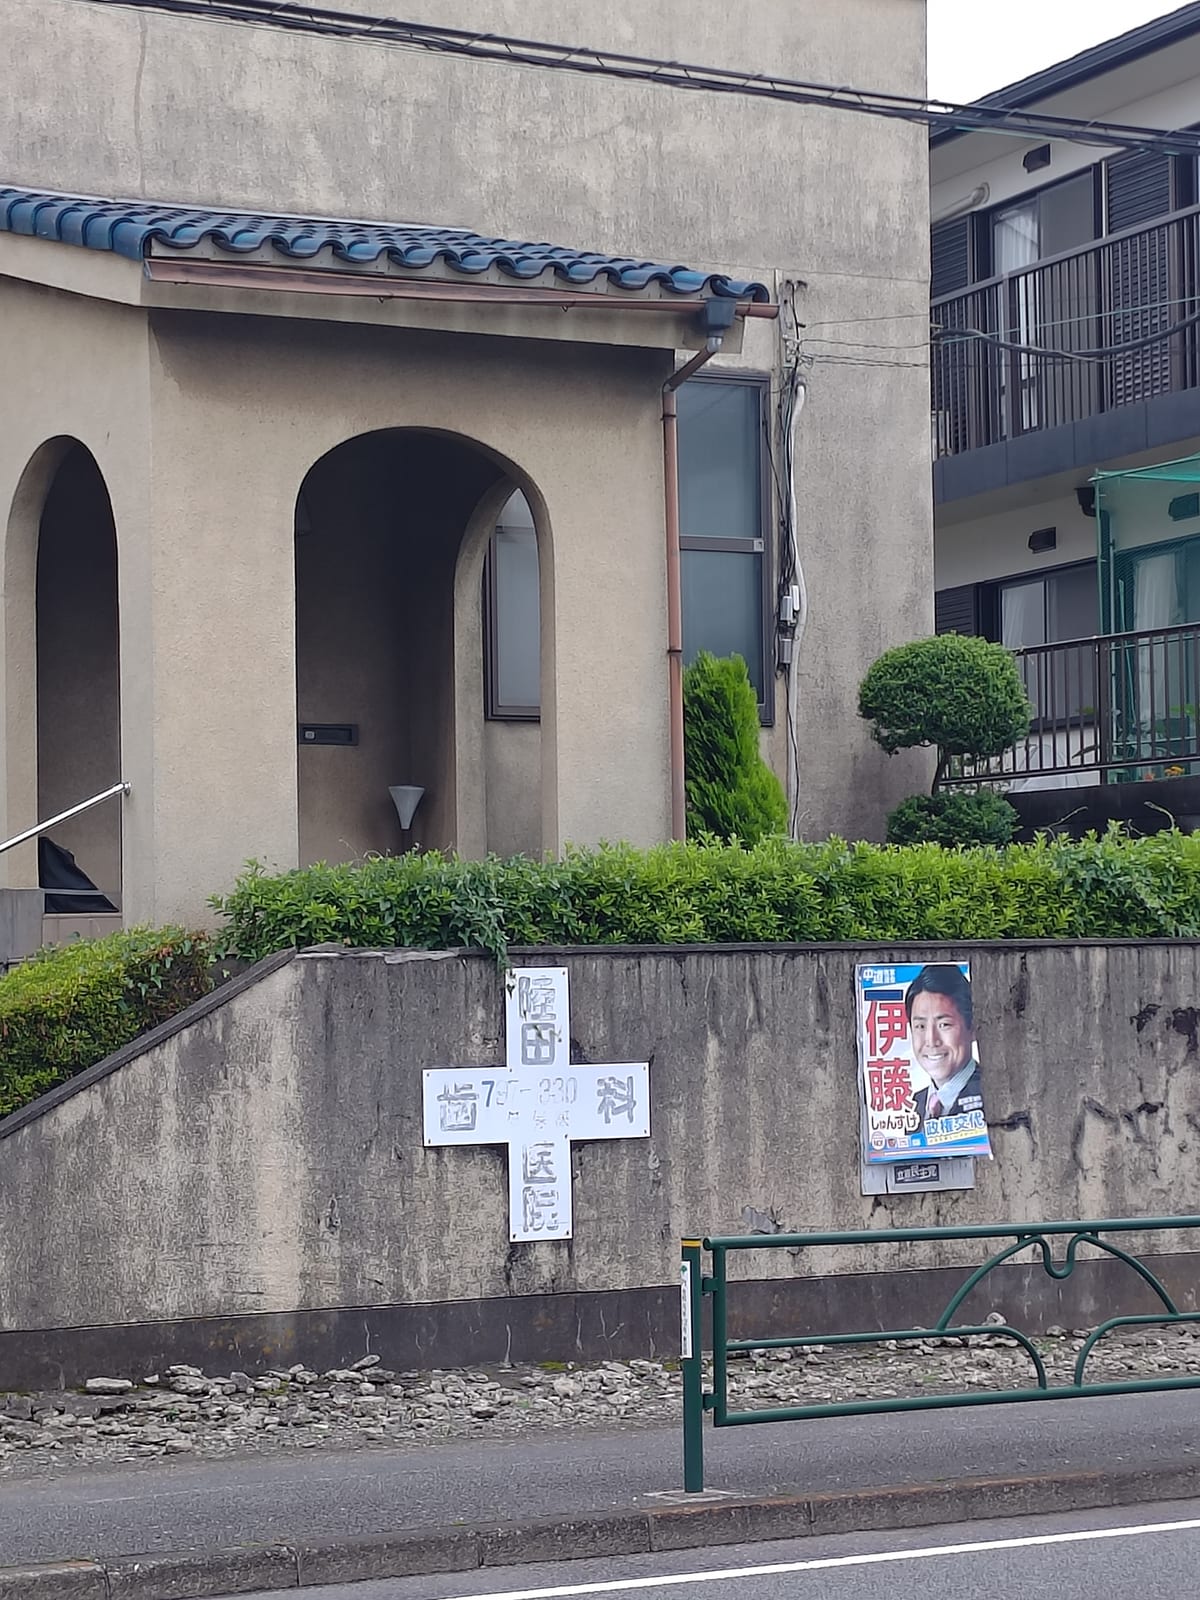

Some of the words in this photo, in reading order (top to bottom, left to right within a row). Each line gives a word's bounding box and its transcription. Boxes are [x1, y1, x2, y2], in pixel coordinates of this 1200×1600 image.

[866, 1000, 913, 1111] 伊藤
[871, 1114, 917, 1130] しゅんすけ
[926, 1112, 984, 1135] 政権交代
[522, 1141, 559, 1232] 医院
